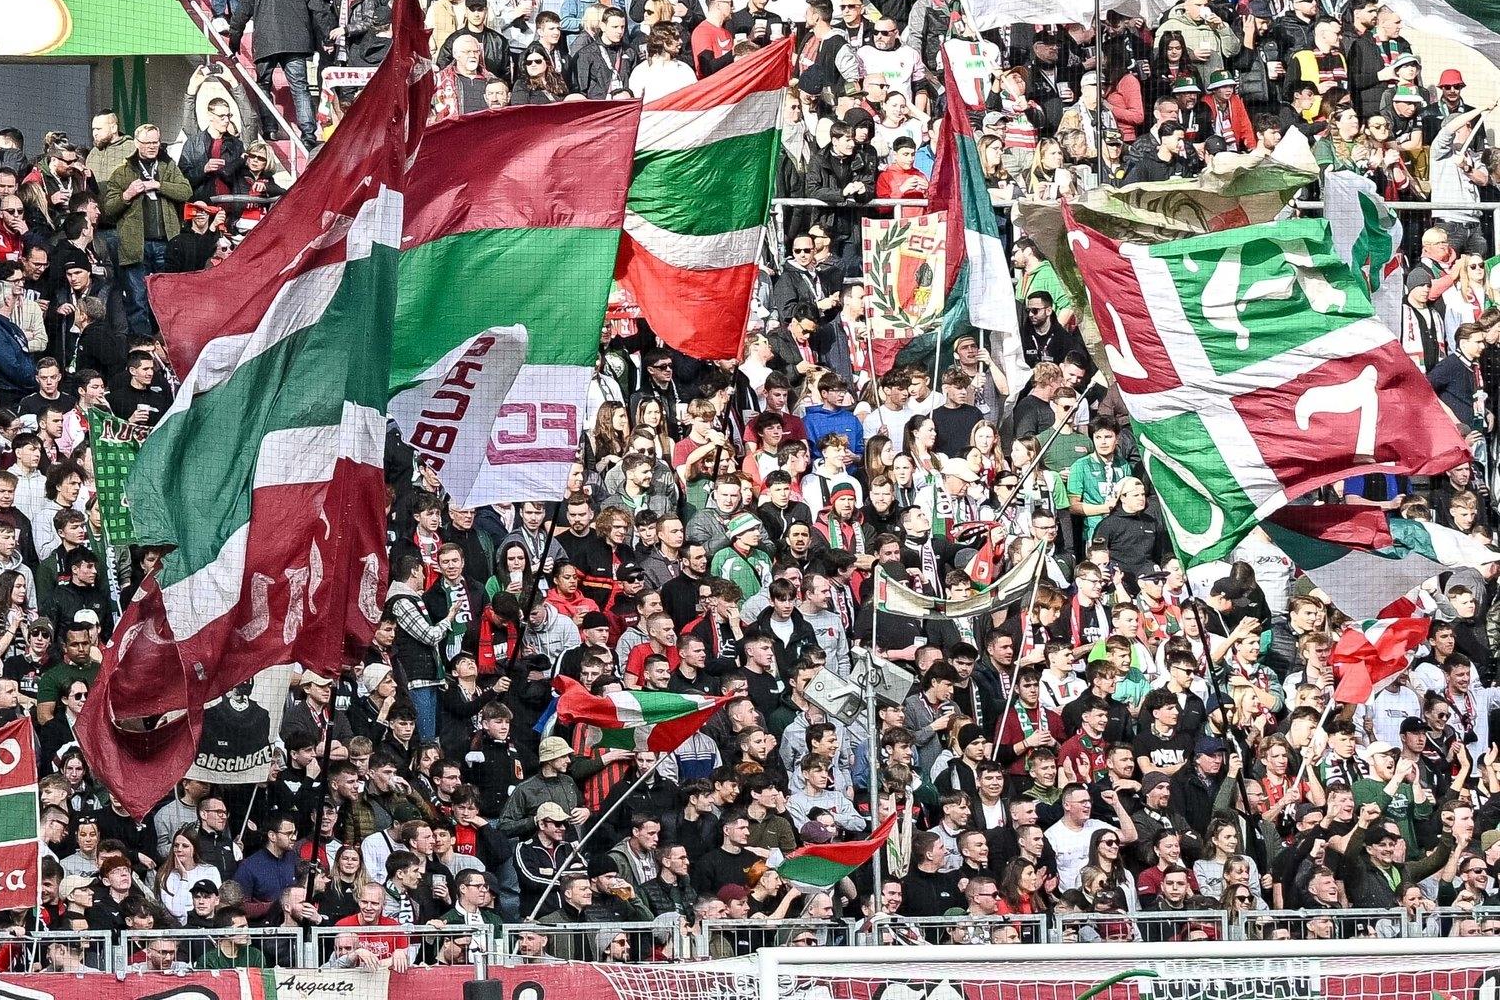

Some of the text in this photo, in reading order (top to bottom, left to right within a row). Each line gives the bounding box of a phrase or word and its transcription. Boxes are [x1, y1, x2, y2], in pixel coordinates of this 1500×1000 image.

[196, 744, 274, 772] abschAFFE
[457, 843, 474, 854] 1907
[276, 974, 355, 996] Augusta
